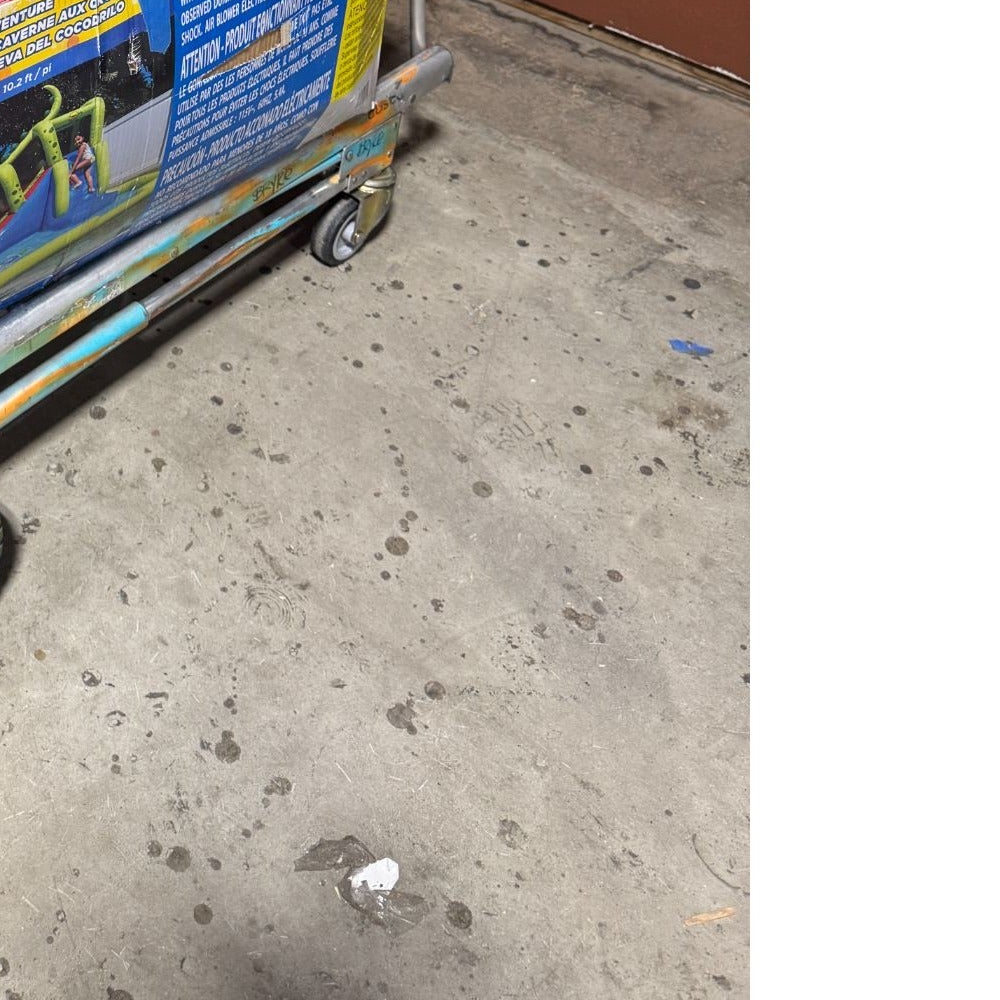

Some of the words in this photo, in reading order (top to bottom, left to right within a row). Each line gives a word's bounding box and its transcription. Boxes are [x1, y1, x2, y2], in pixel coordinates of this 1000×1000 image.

[25, 39, 53, 60] DEL
[54, 0, 126, 42] COCODRILO
[57, 3, 87, 26] AUX
[204, 16, 215, 34] AIR
[216, 3, 239, 27] BLOWER
[180, 35, 220, 81] ATTENTION
[224, 15, 257, 56] PRODUIT
[2, 77, 23, 93] 10.2
[23, 72, 34, 85] ft
[41, 62, 53, 79] pi
[179, 84, 187, 99] LE
[200, 86, 212, 103] PAR
[212, 78, 224, 96] DES
[224, 71, 236, 88] LES
[207, 96, 219, 113] LES
[248, 87, 260, 103] LES
